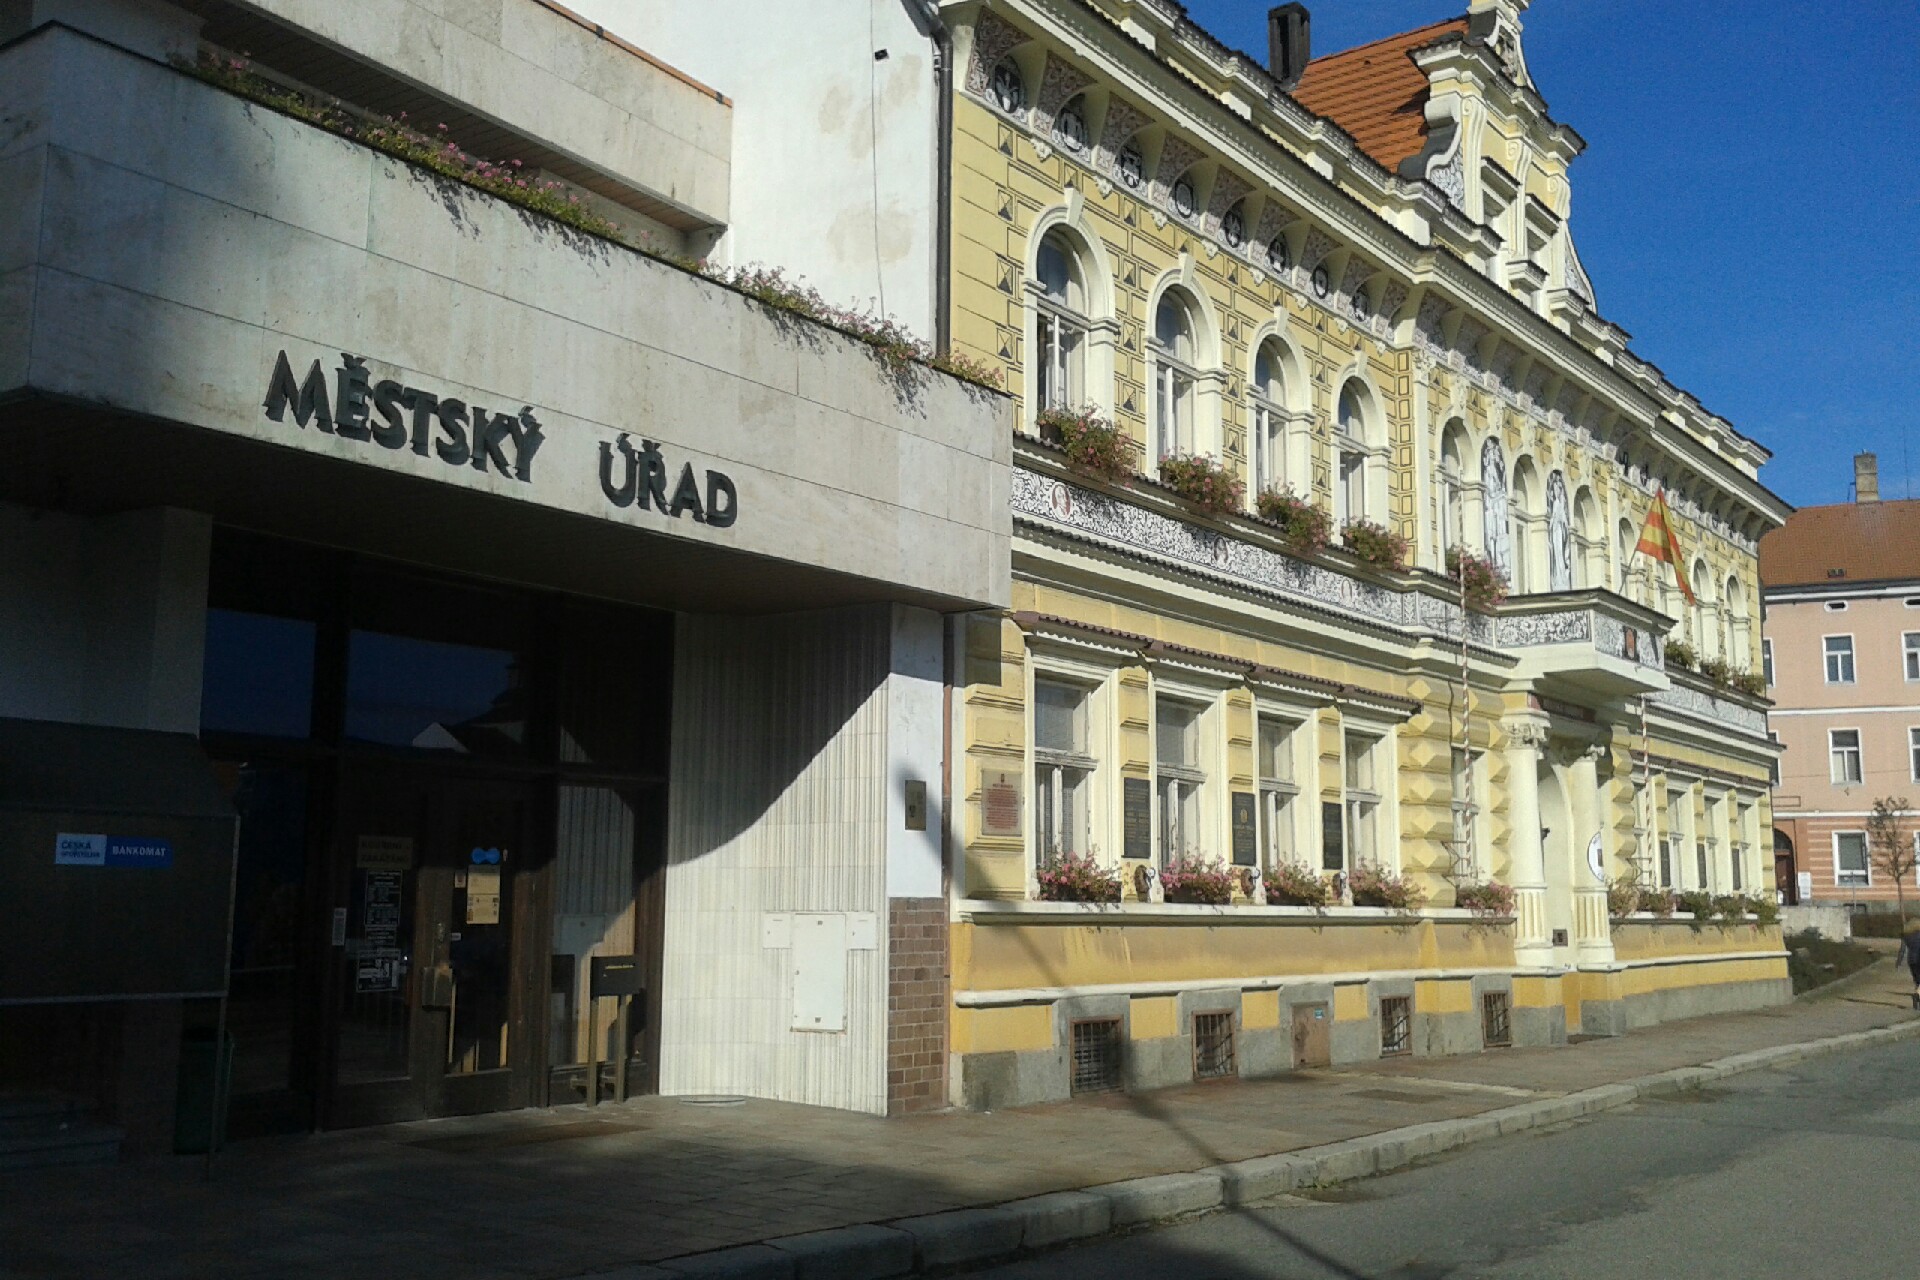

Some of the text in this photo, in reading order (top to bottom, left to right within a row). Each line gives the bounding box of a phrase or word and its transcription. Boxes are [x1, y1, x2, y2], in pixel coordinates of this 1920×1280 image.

[262, 350, 738, 528] MĚSTSKÝ ÚŘAD
[112, 845, 166, 856] BANKOMAT
